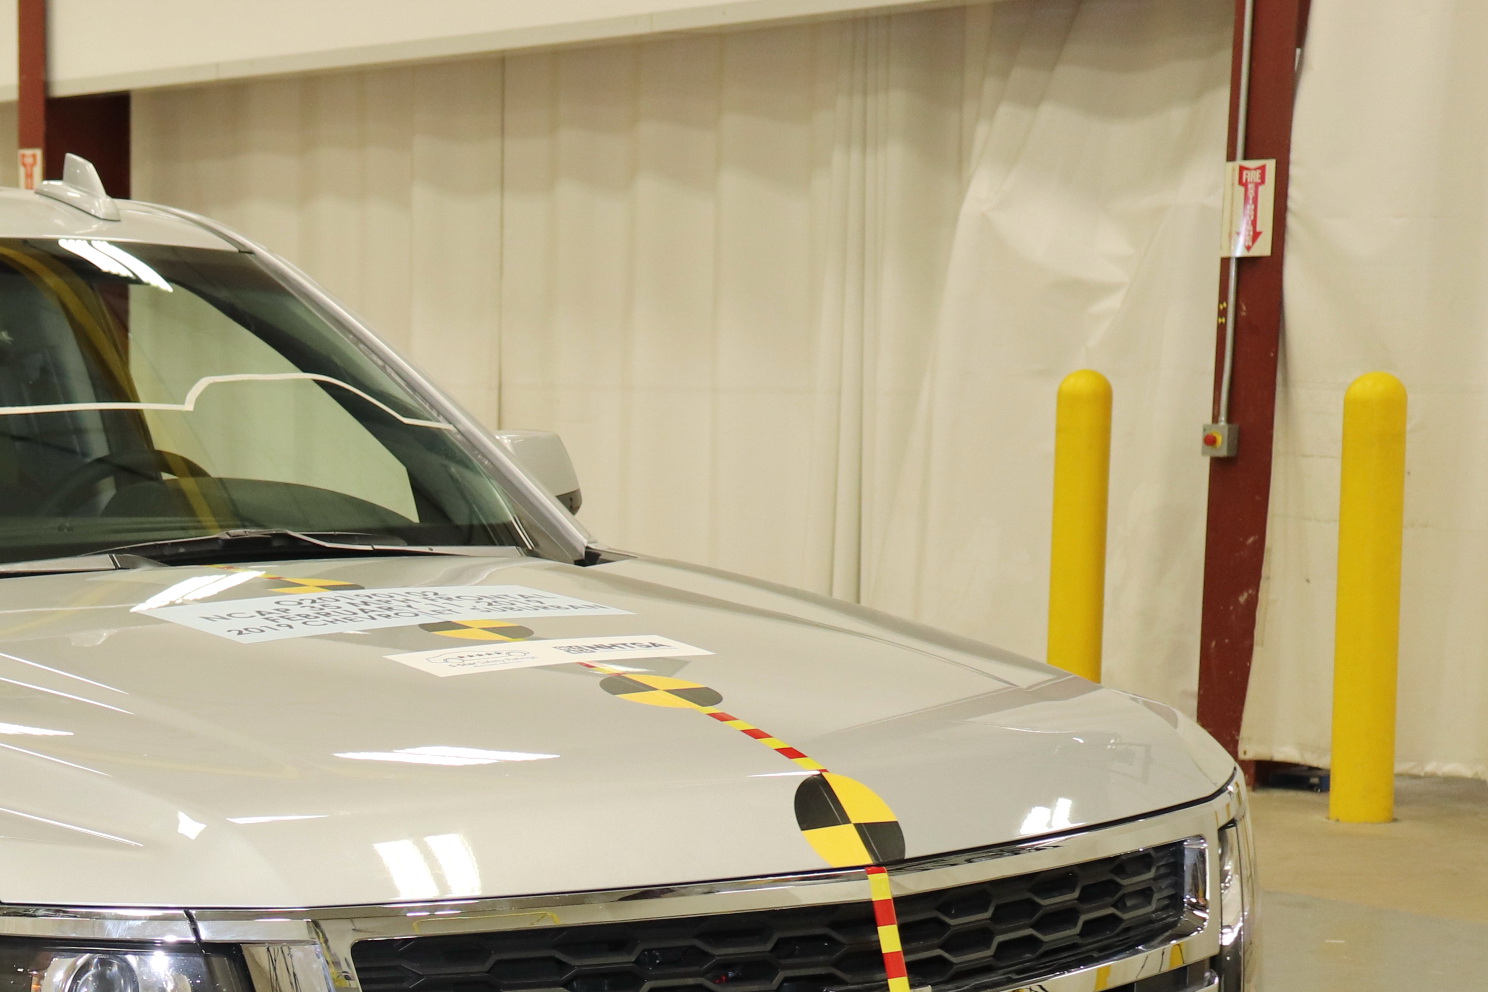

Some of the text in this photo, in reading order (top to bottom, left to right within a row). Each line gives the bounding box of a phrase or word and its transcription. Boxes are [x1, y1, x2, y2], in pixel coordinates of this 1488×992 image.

[1242, 170, 1262, 183] FIRE
[198, 607, 292, 622] NCAP
[299, 603, 342, 612] 35
[226, 604, 610, 635] 2019 CHEVROLET SUBURBAN
[262, 605, 419, 623] FEBRUARY
[583, 641, 671, 651] NHTSA
